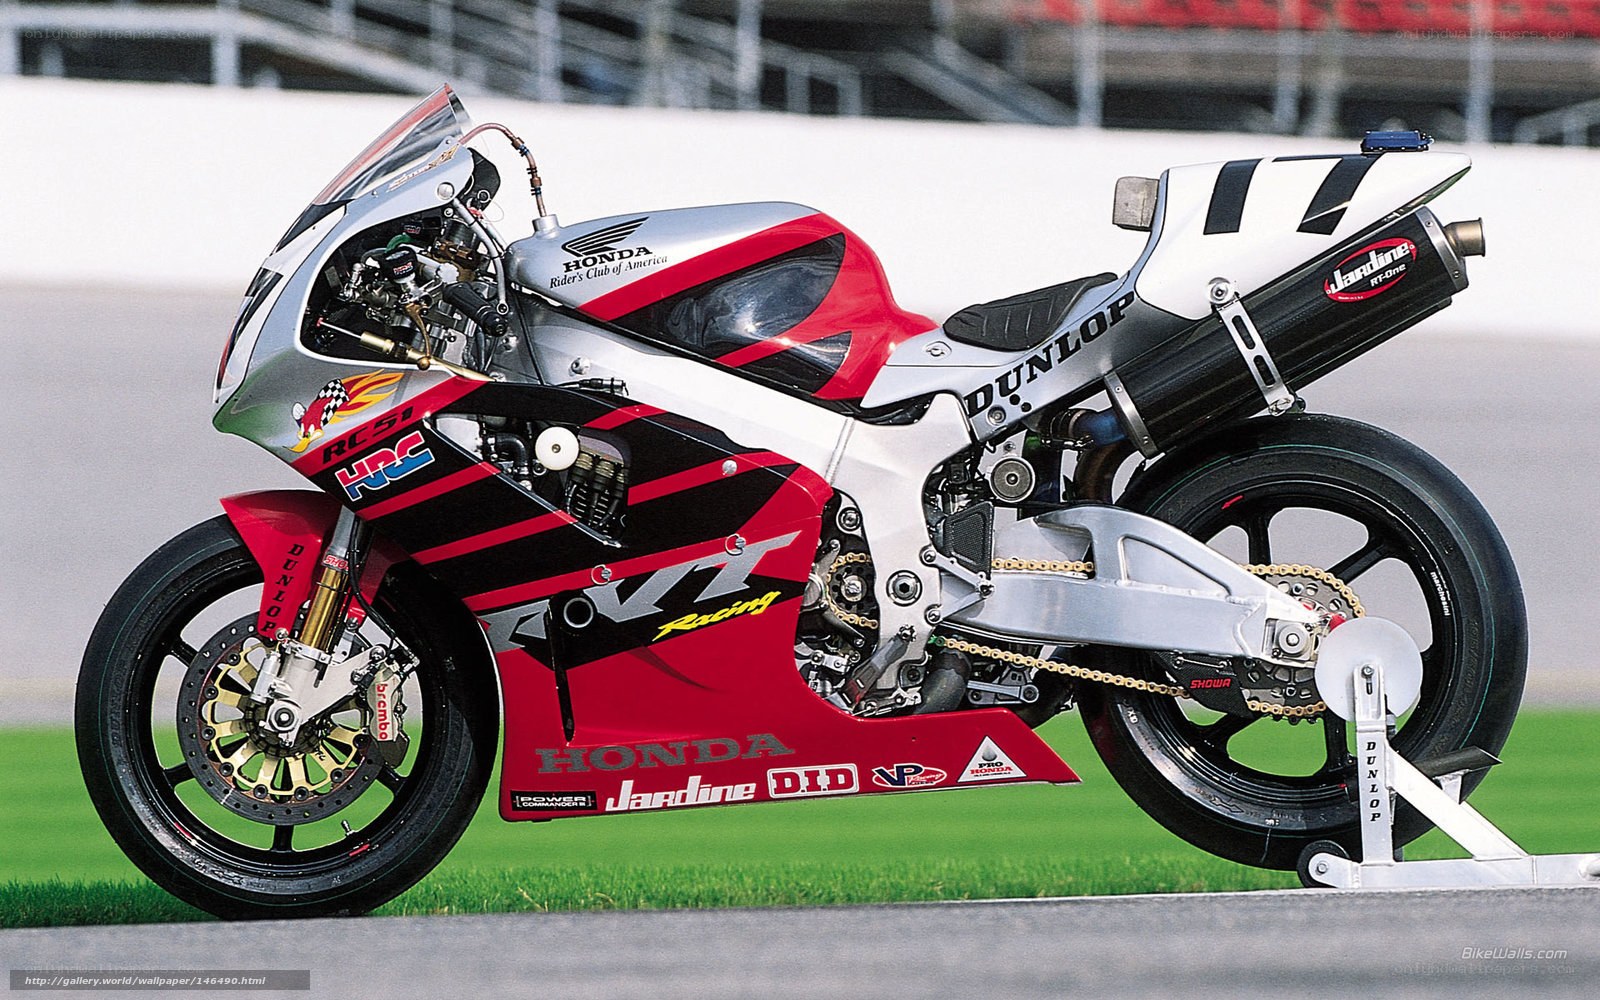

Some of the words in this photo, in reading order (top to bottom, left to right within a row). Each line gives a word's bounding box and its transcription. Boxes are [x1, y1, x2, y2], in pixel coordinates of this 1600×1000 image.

[549, 271, 584, 289] Rider's
[586, 265, 610, 280] Club
[612, 262, 622, 276] of
[624, 255, 668, 271] America
[563, 246, 653, 273] HONDA
[1329, 241, 1410, 295] Jardine
[1369, 263, 1407, 288] RT-One
[963, 291, 1136, 418] DUNLOP
[322, 405, 415, 464] RC51
[335, 430, 435, 502] HRC
[324, 554, 349, 571] SHO
[260, 543, 305, 633] DUNLOP
[651, 590, 782, 642] Racing
[1190, 677, 1232, 690] SHOWA
[376, 682, 391, 741] brembo
[535, 732, 796, 775] HONDA
[969, 766, 1013, 775] HONDA
[978, 761, 1004, 769] PRO
[605, 775, 756, 812] Jardine
[872, 763, 925, 788] VP
[1365, 740, 1383, 823] DUNLOP
